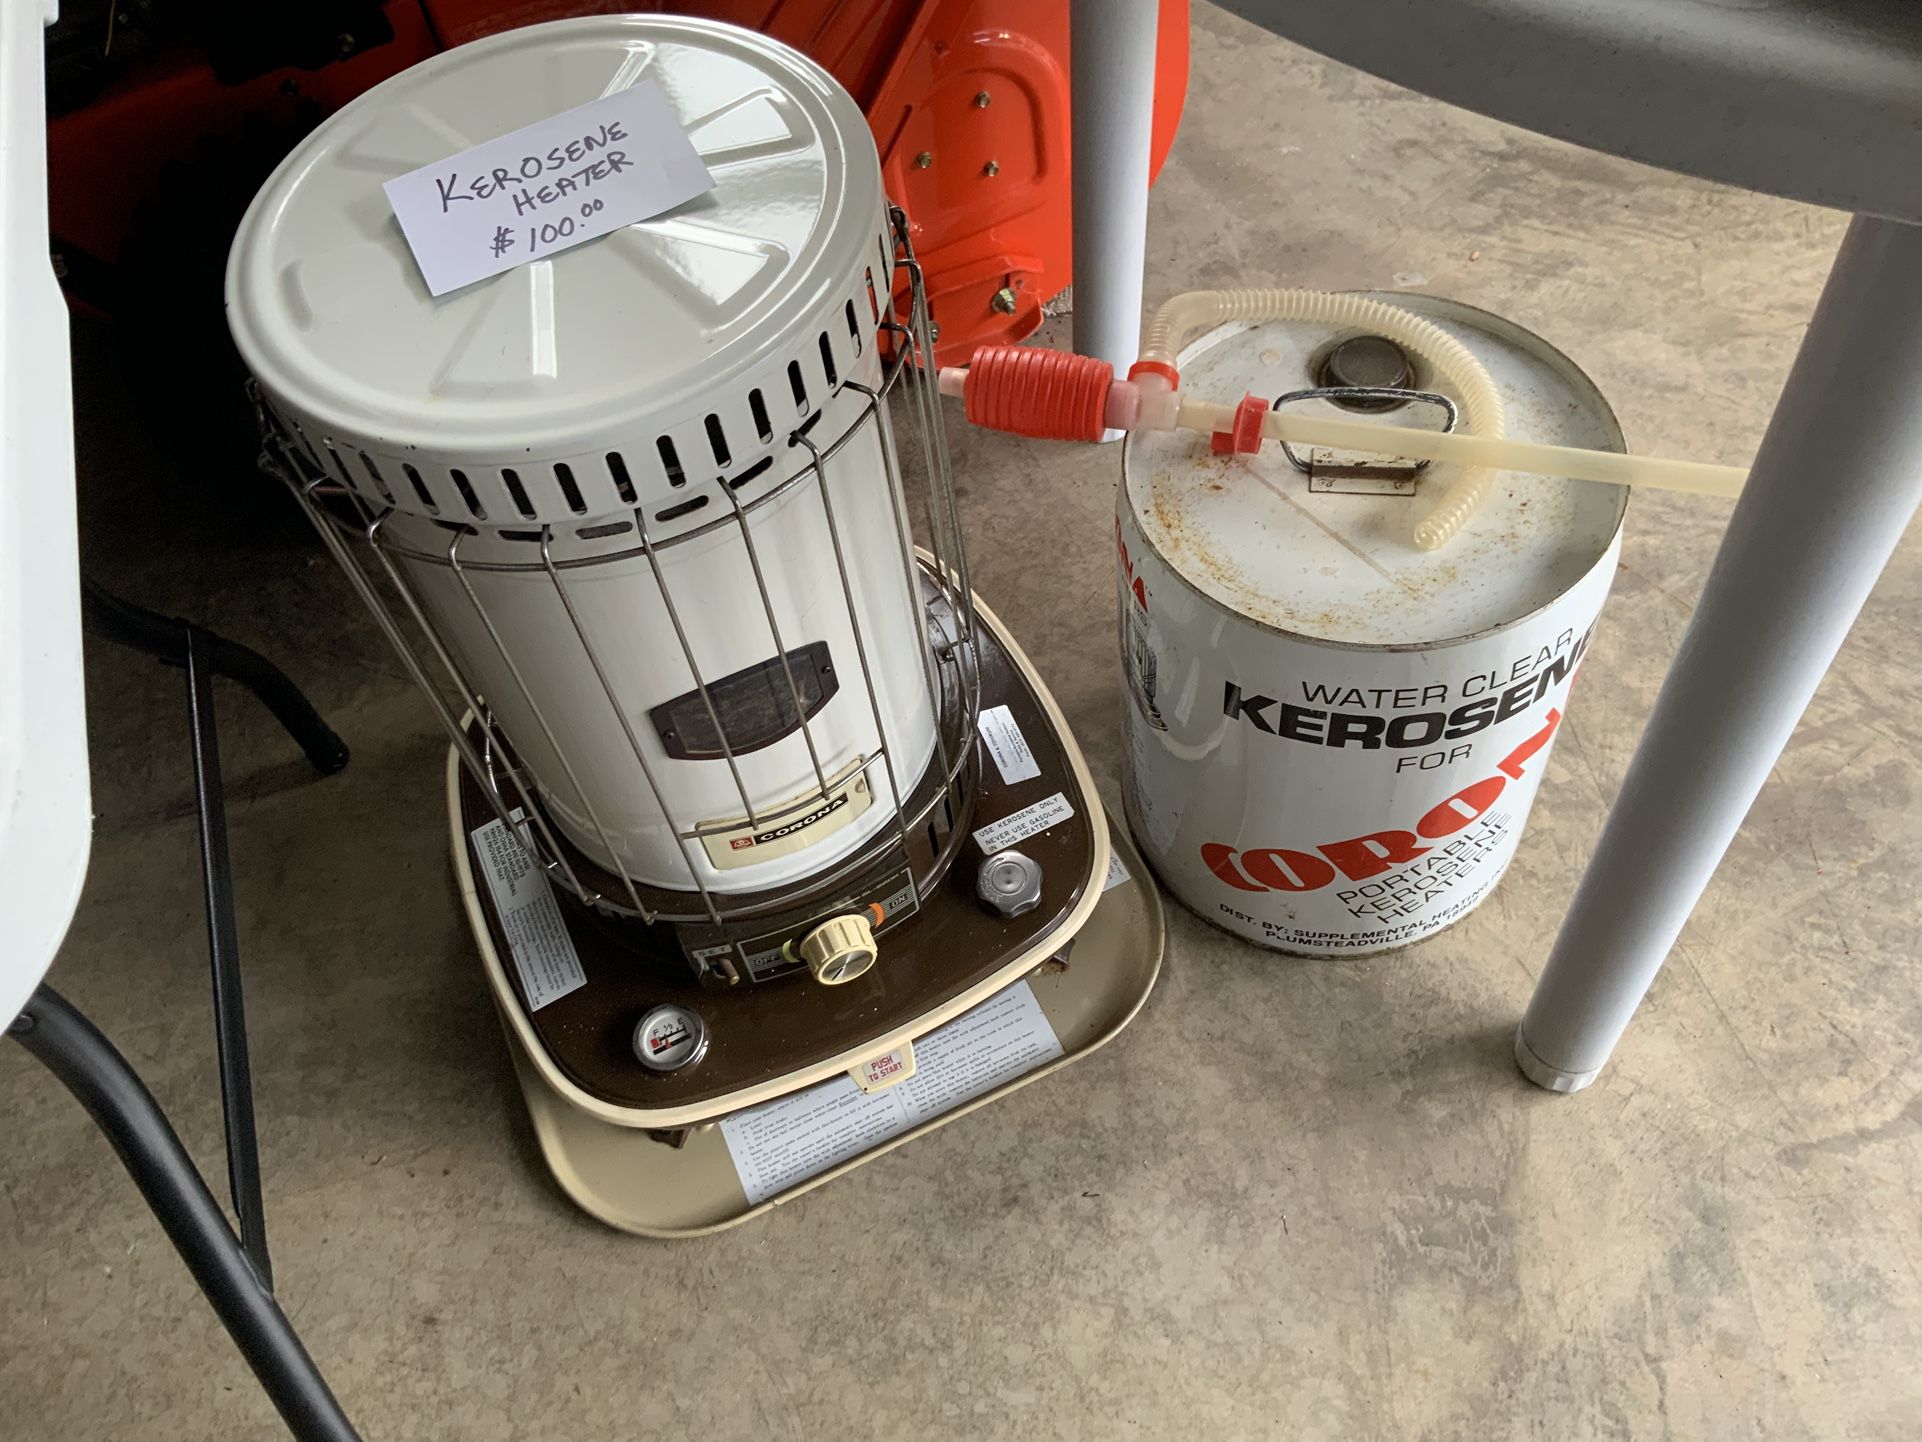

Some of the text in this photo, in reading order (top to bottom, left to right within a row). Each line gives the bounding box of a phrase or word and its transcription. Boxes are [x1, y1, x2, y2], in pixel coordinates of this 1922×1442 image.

[436, 121, 628, 213] KEROSENE
[512, 151, 634, 216] HEATER
[1302, 628, 1573, 710] WATER CLEAR
[1396, 744, 1471, 773] FOR
[761, 800, 843, 841] CORONA
[979, 796, 1058, 837] USE KEROSENE ONLY
[985, 805, 1064, 845] NEVER USE GASOLINE
[1000, 835, 1017, 846] THIS
[1020, 820, 1049, 836] HEATER
[1336, 809, 1500, 904] PORTABLE
[1348, 813, 1511, 919] KEROSENE
[1377, 828, 1510, 924] HEATERS
[891, 895, 906, 908] ON
[1219, 903, 1257, 925] DIST.
[1261, 921, 1288, 934] BY:
[1294, 920, 1427, 940] SUPPLEMENTAL
[1423, 920, 1440, 932] PA
[868, 1062, 903, 1082] TO START
[871, 1055, 893, 1071] PUSH
